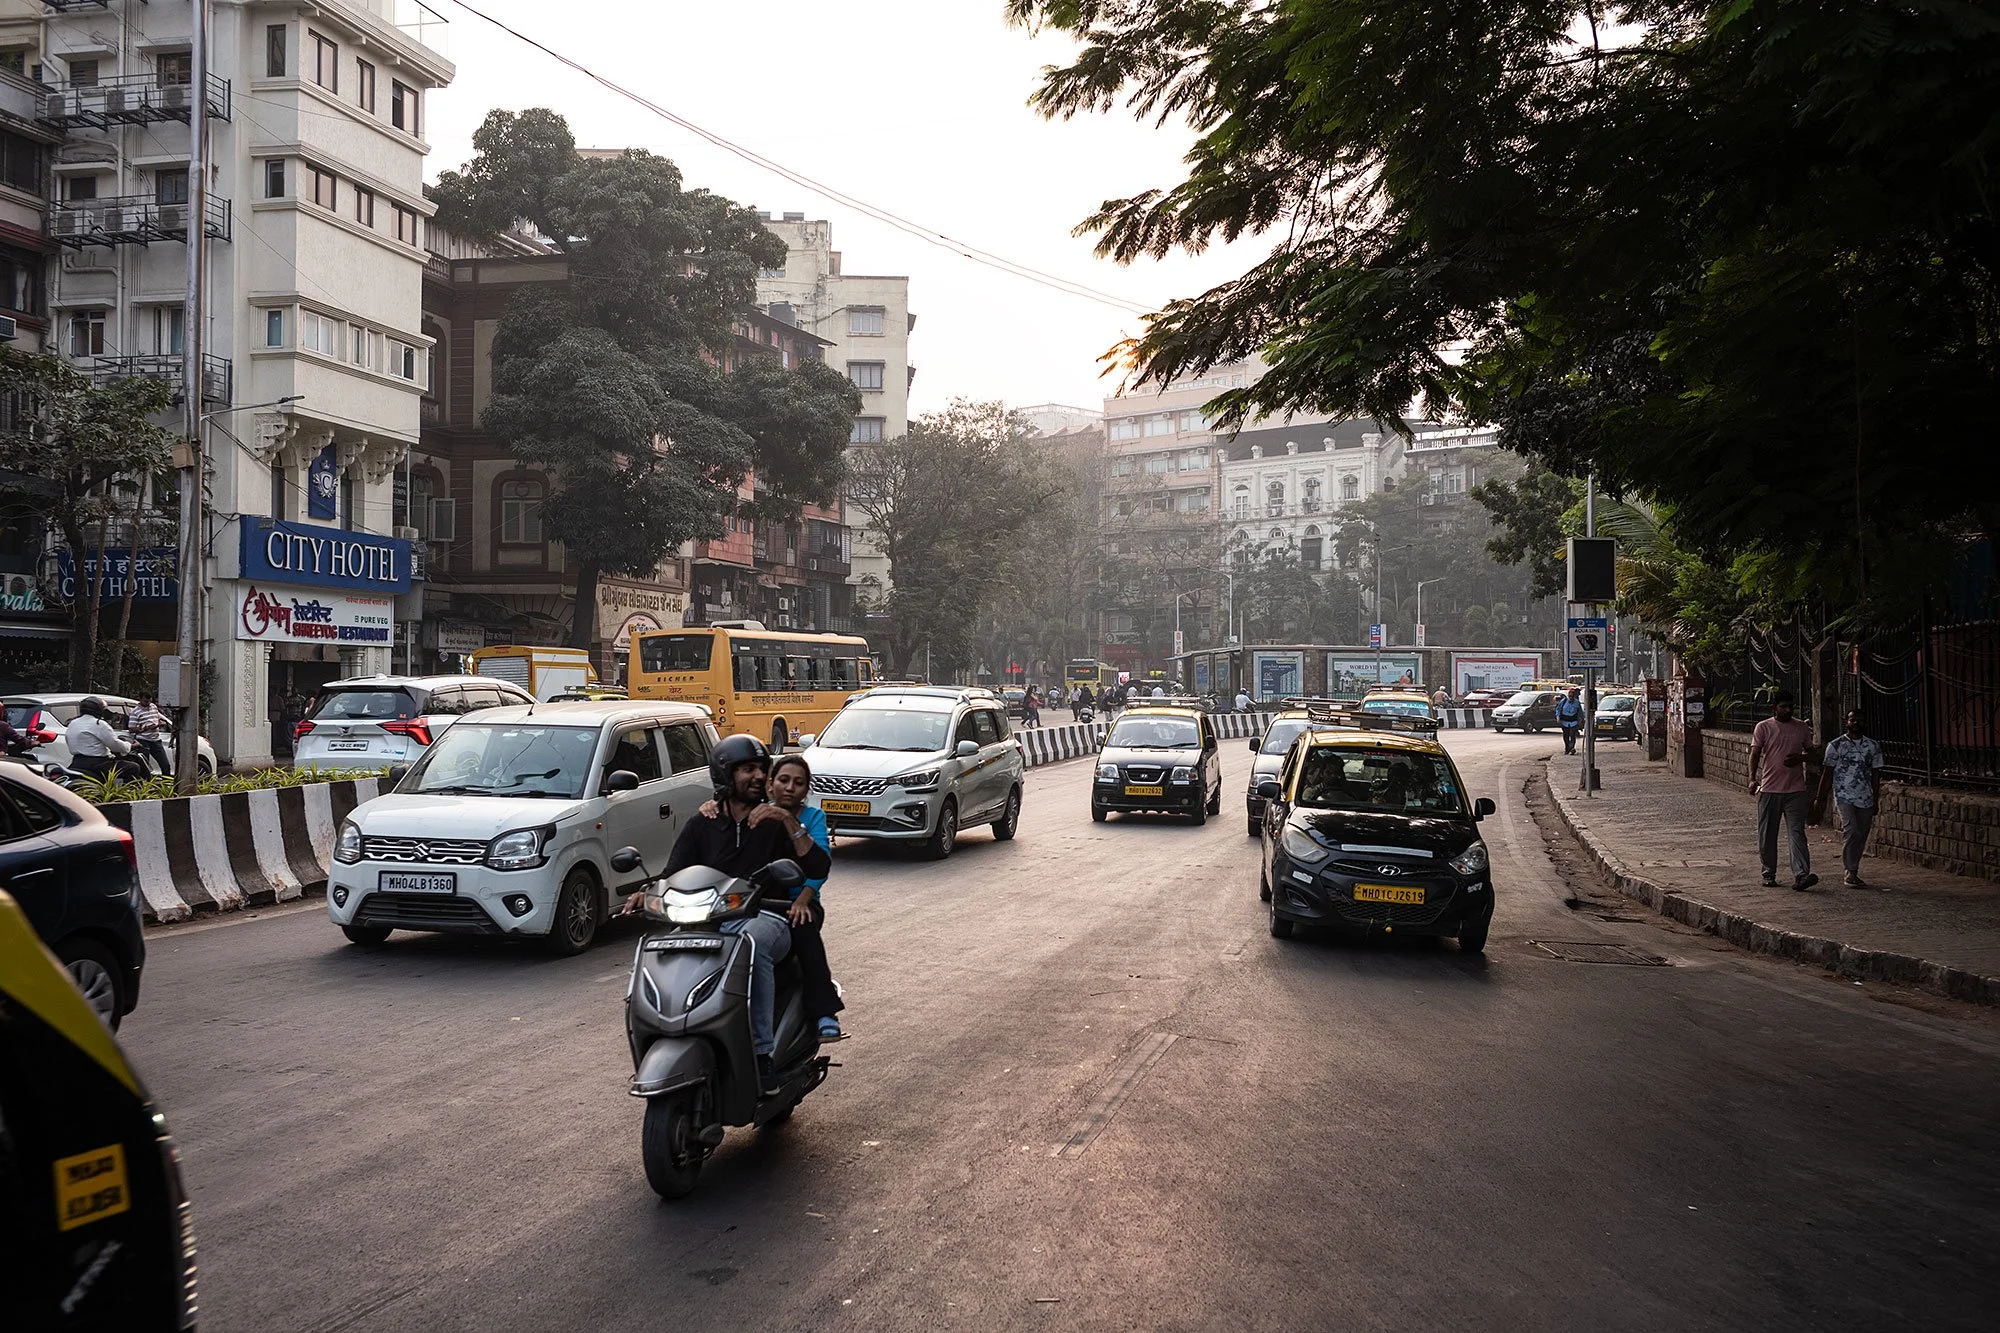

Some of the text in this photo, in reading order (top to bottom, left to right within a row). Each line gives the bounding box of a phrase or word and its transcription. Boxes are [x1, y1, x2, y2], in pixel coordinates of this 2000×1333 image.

[266, 531, 399, 582] CITY HOTEL
[109, 577, 170, 598] HOTEL
[360, 615, 388, 625] PURE VEG
[292, 622, 337, 640] SHREEYOG
[388, 877, 452, 891] MH04LB1360
[1361, 887, 1423, 902] MH01CJ2619
